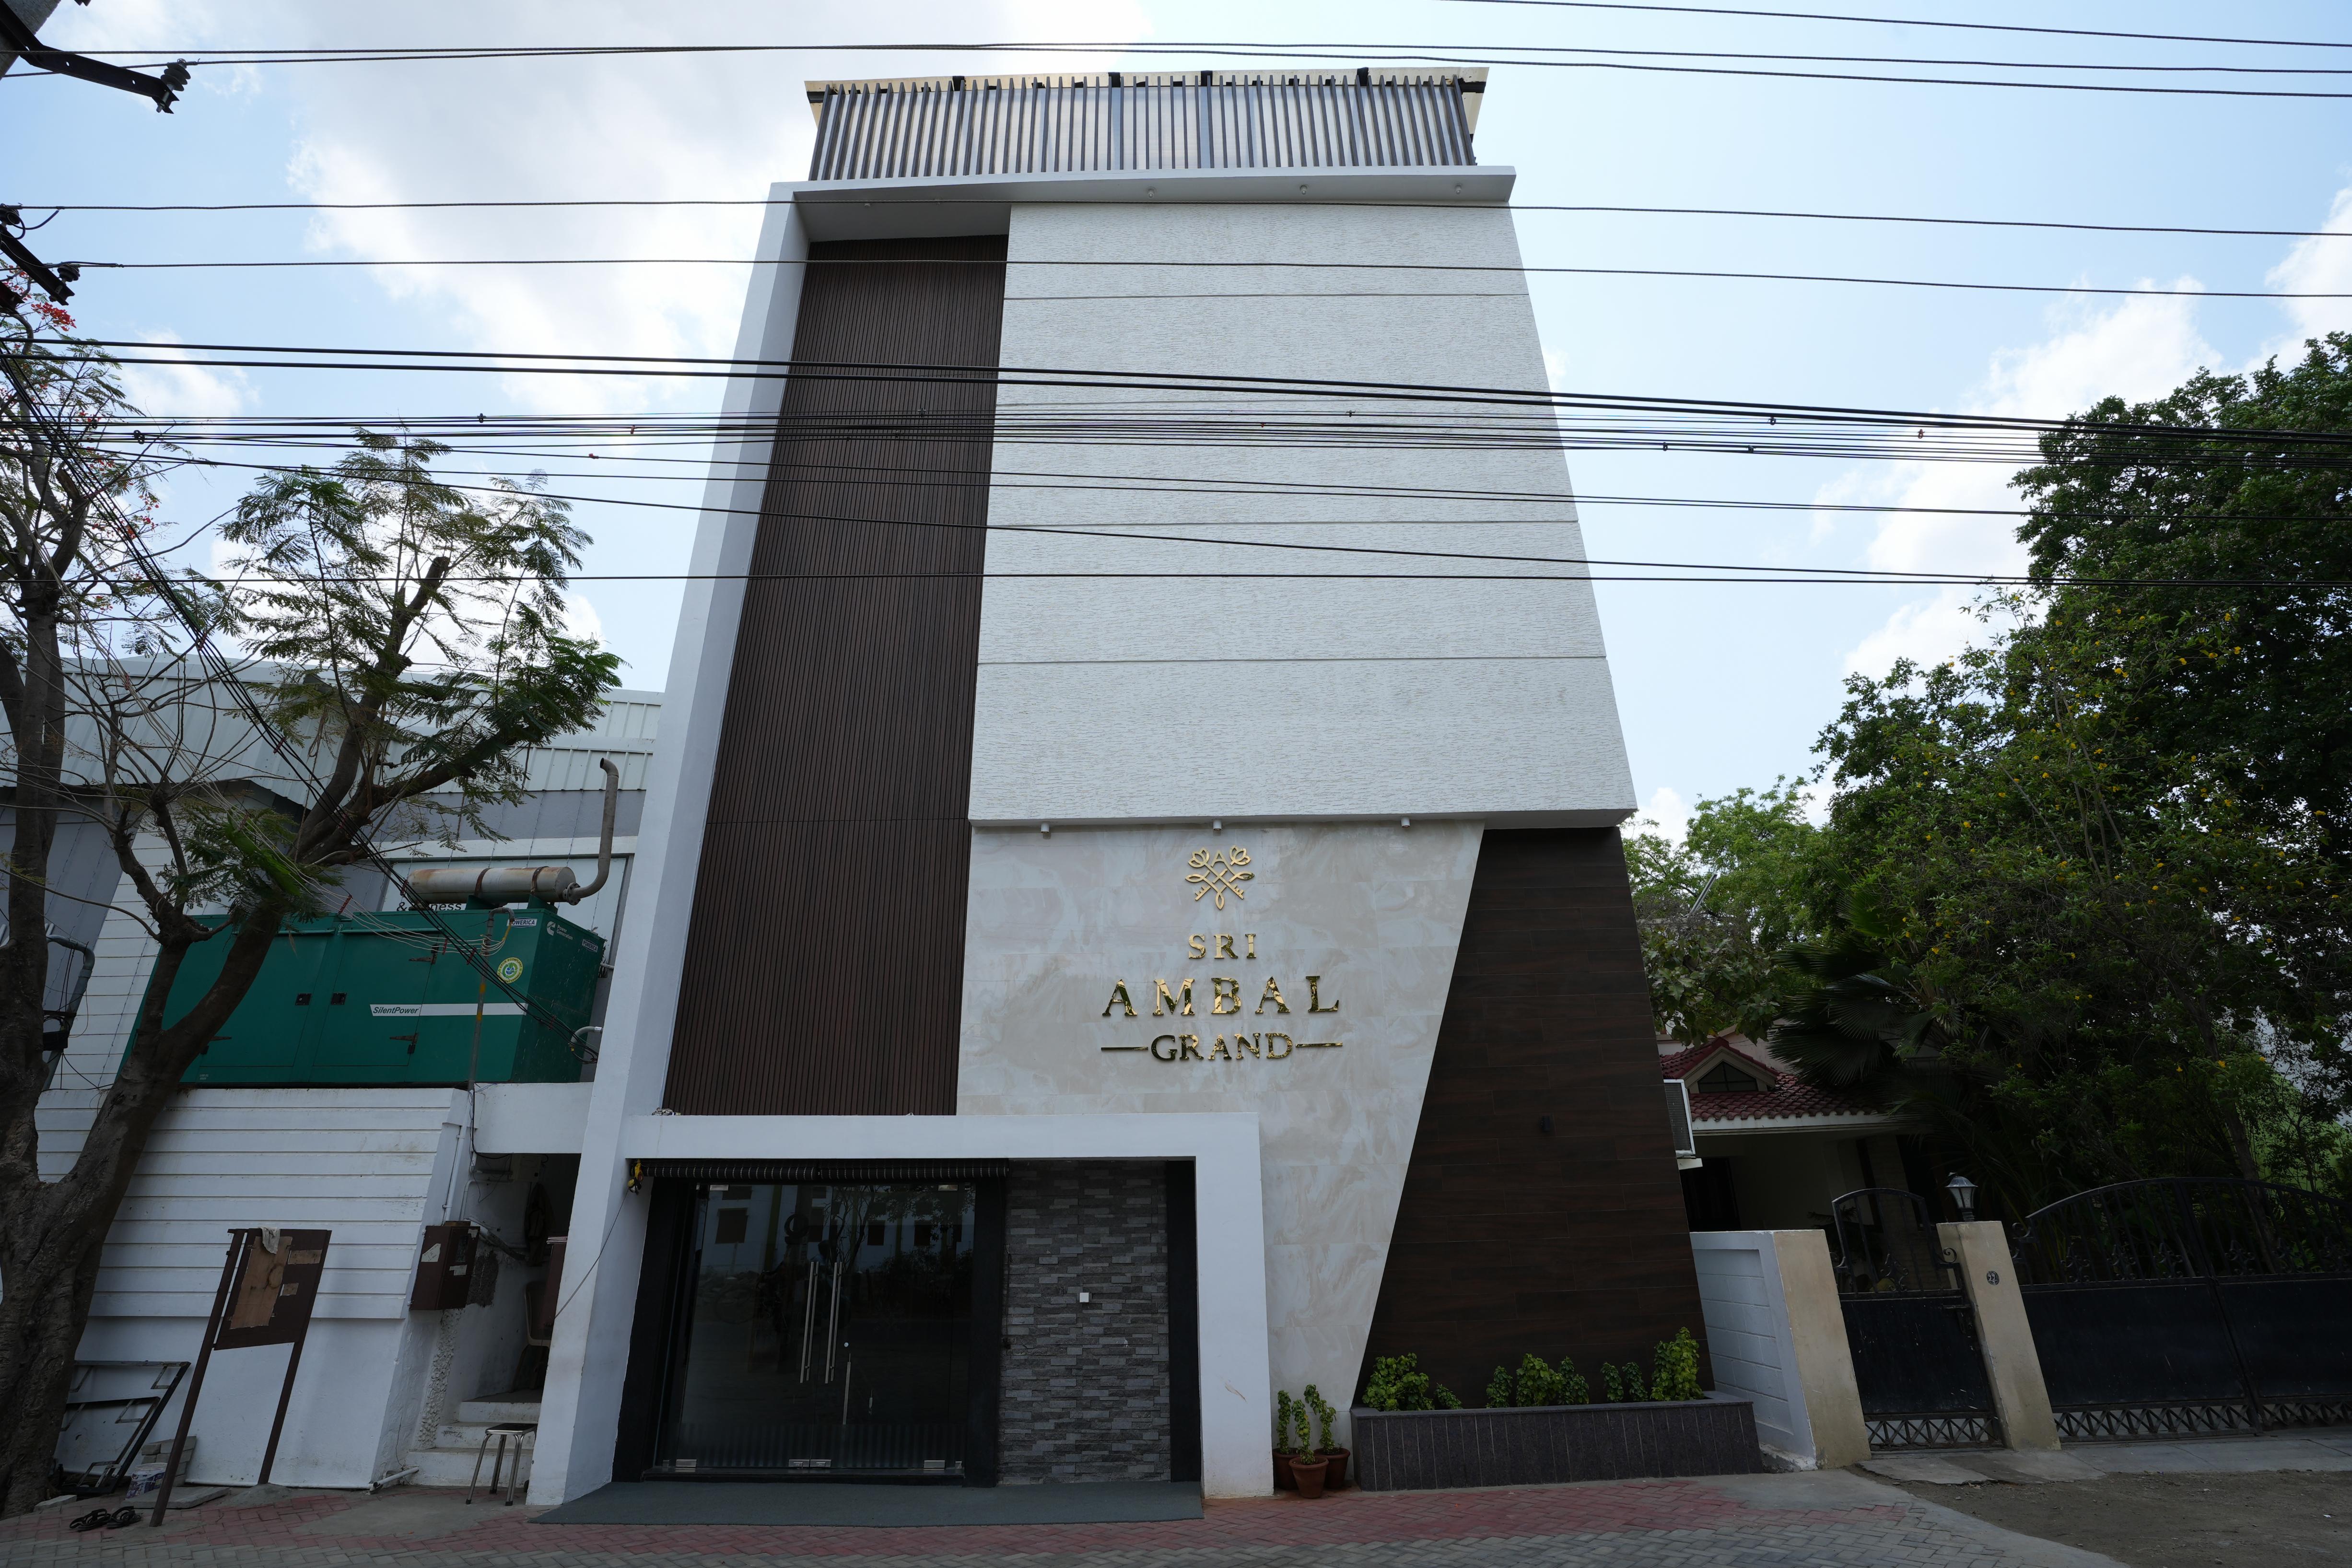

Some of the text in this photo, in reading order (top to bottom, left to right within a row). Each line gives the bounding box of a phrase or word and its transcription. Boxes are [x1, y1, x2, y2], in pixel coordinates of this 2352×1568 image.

[556, 929, 573, 940] Generation
[557, 924, 567, 933] Power
[1188, 934, 1256, 960] SRI
[1102, 975, 1339, 1017] AMBAL
[1151, 1032, 1293, 1061] GRAND
